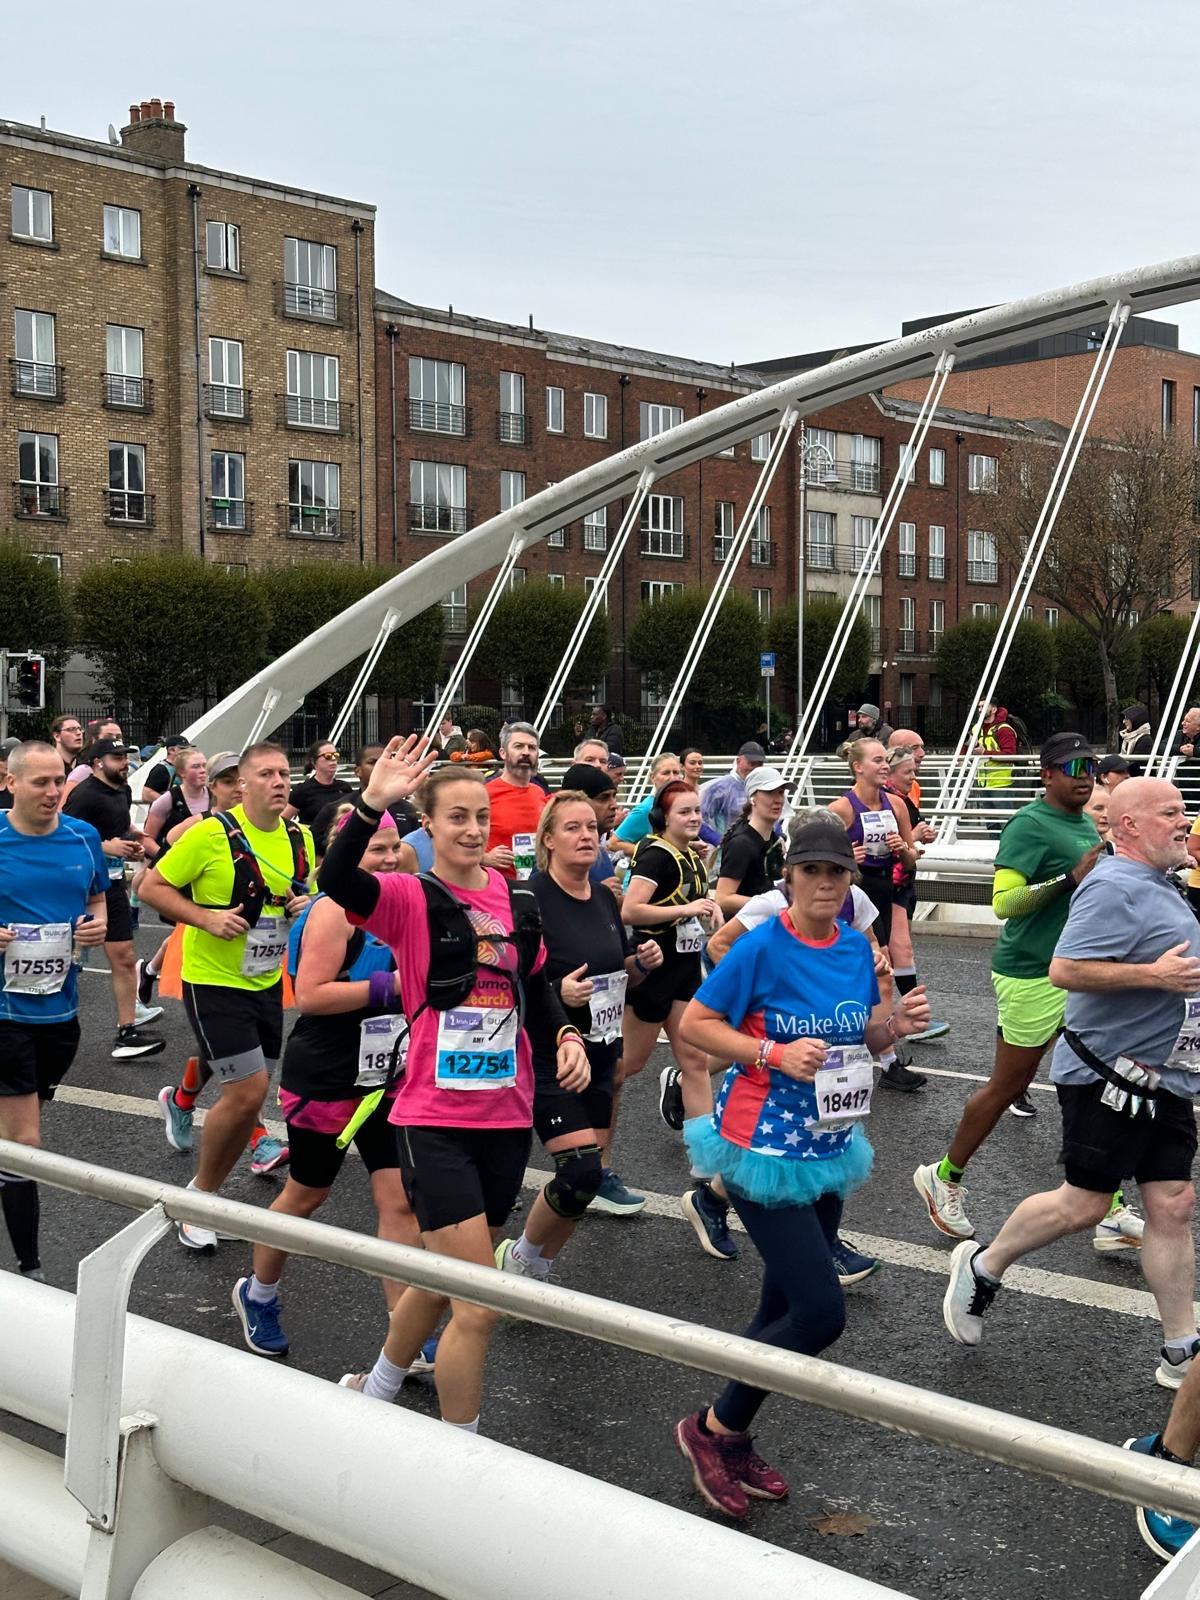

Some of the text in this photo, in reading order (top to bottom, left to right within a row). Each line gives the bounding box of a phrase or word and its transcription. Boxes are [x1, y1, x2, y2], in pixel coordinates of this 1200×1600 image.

[867, 831, 897, 843] 224
[680, 937, 699, 950] 176
[12, 958, 65, 975] 17553
[465, 991, 509, 1006] earch
[596, 1004, 622, 1026] 17914
[472, 1036, 485, 1044] AMY
[445, 1054, 510, 1075] 12754
[823, 1088, 869, 1114] 18417
